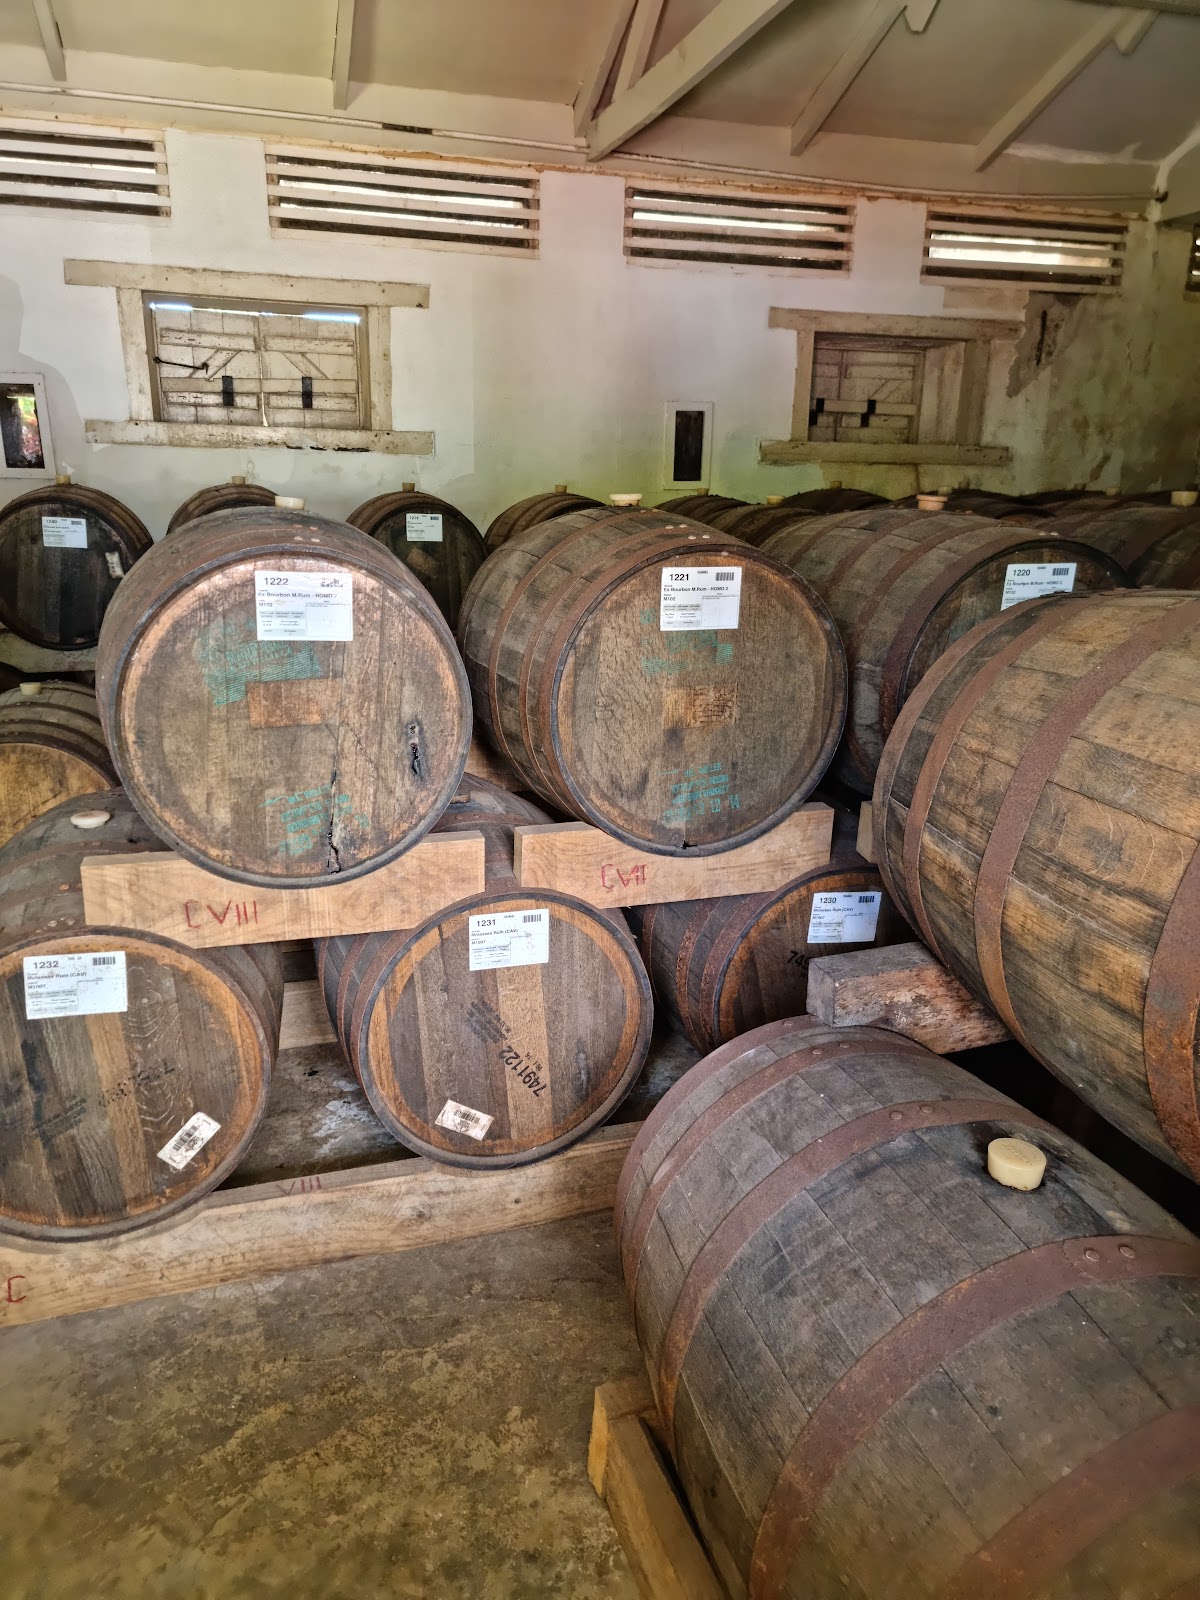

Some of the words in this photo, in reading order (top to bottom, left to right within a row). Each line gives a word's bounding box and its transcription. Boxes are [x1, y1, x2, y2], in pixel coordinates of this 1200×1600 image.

[669, 573, 689, 581] 1221
[1013, 569, 1031, 577] 1220
[264, 577, 289, 586] 1222
[477, 919, 496, 927] 1231
[33, 960, 60, 969] 1232
[500, 1045, 547, 1097] 7491122
[7, 1274, 27, 1303] C
